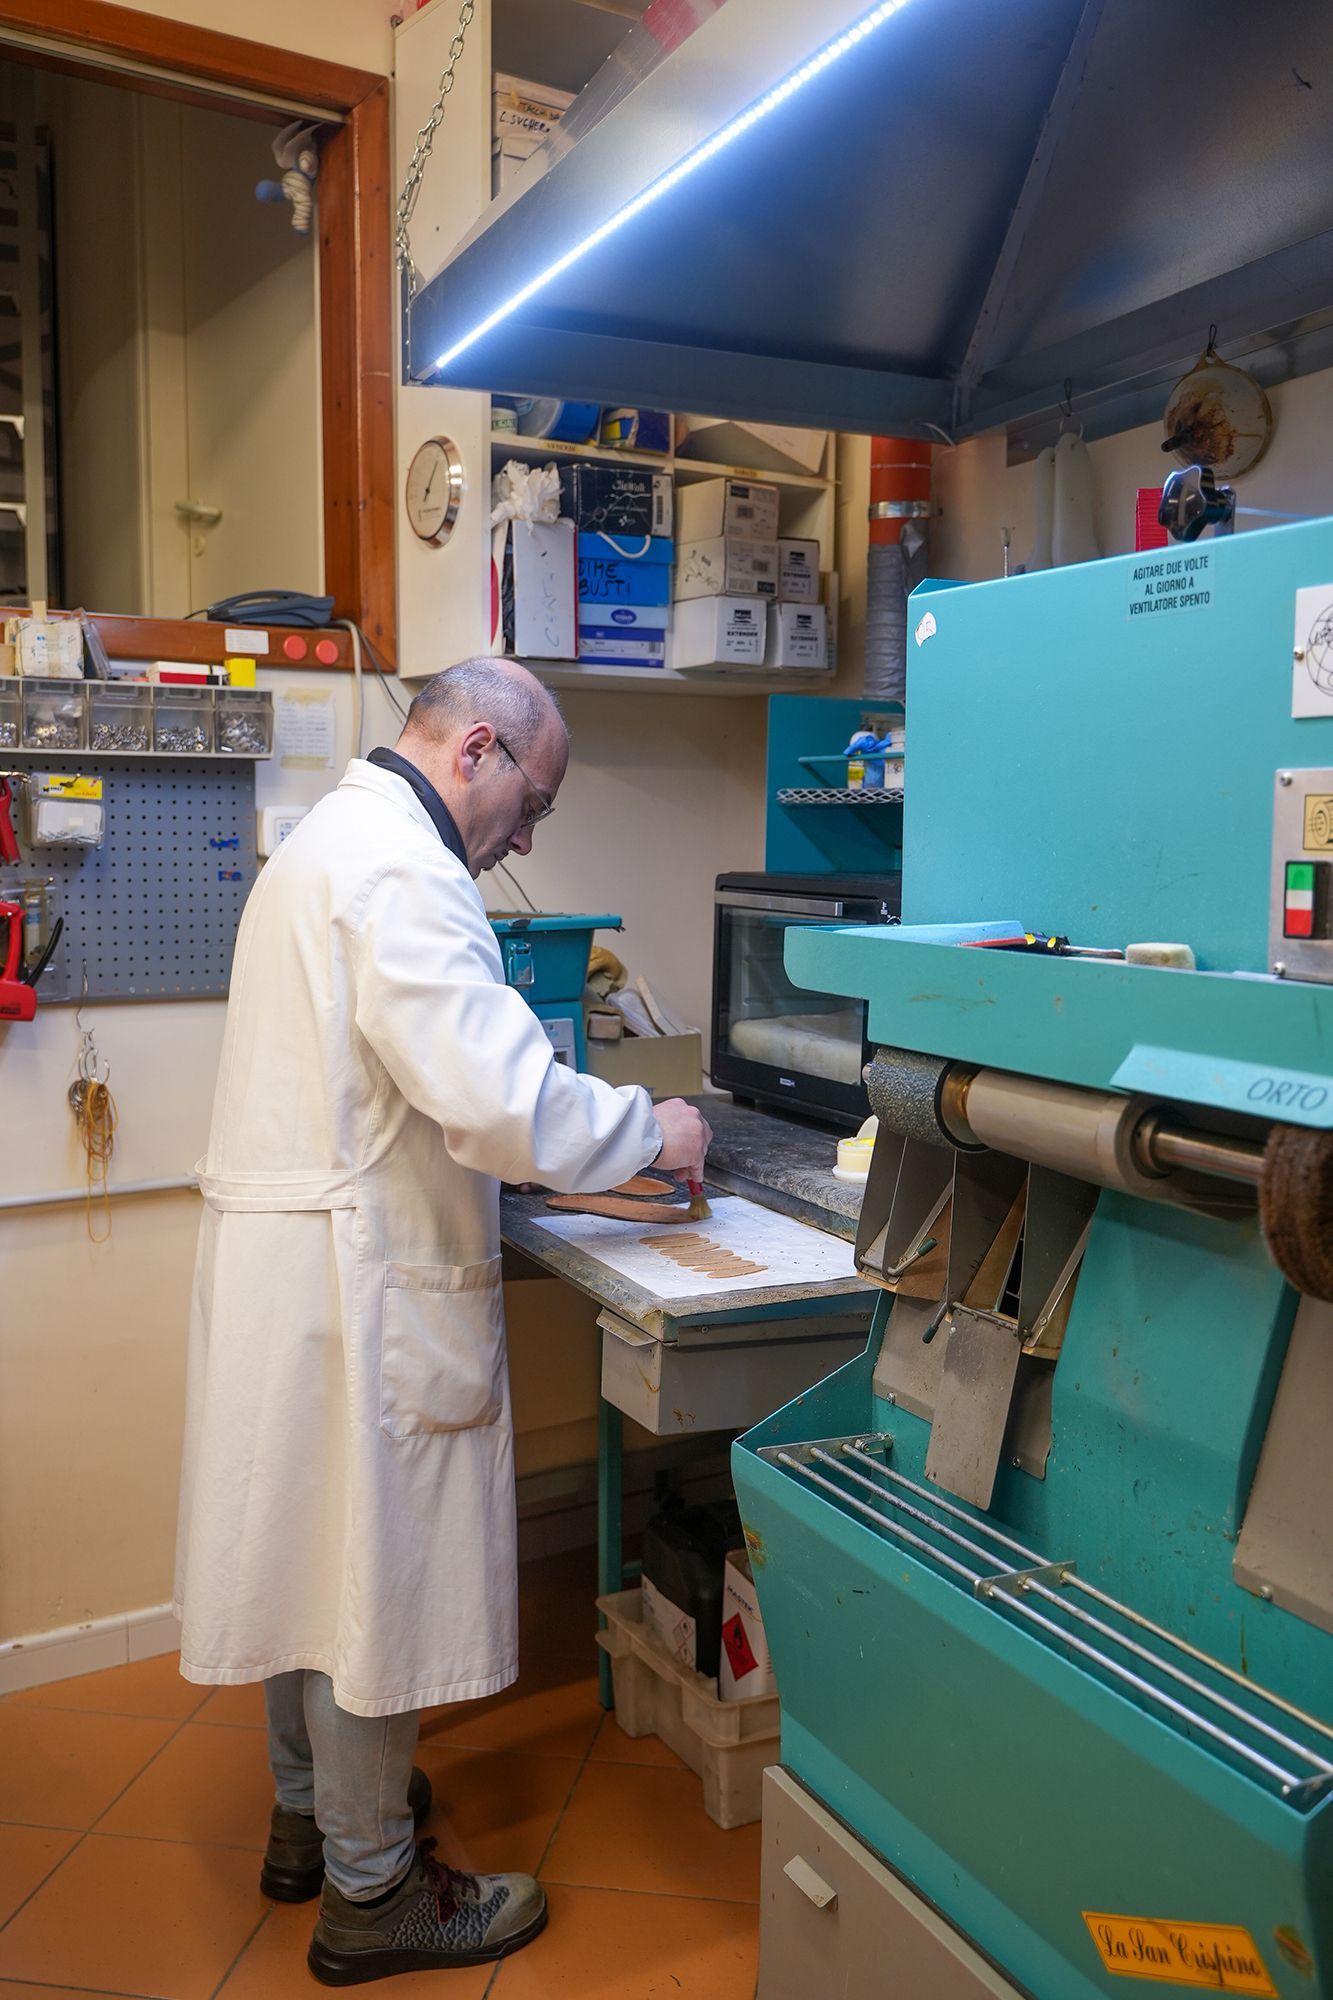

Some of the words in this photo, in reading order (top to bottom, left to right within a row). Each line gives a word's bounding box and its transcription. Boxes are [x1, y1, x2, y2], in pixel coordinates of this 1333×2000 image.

[1133, 563, 1164, 581] AGITARE
[1166, 560, 1182, 575] DUE
[1184, 556, 1209, 572] VOLTE
[1145, 583, 1154, 596] AL
[1156, 577, 1187, 594] GIORNO
[1188, 576, 1194, 589] A
[1129, 596, 1178, 615] VENTILATORE
[1179, 591, 1210, 608] SPENTO
[1247, 1077, 1328, 1112] ORTO
[1098, 1924, 1128, 1959] La
[1128, 1927, 1171, 1964] San
[1169, 1932, 1261, 1986] Crispino
